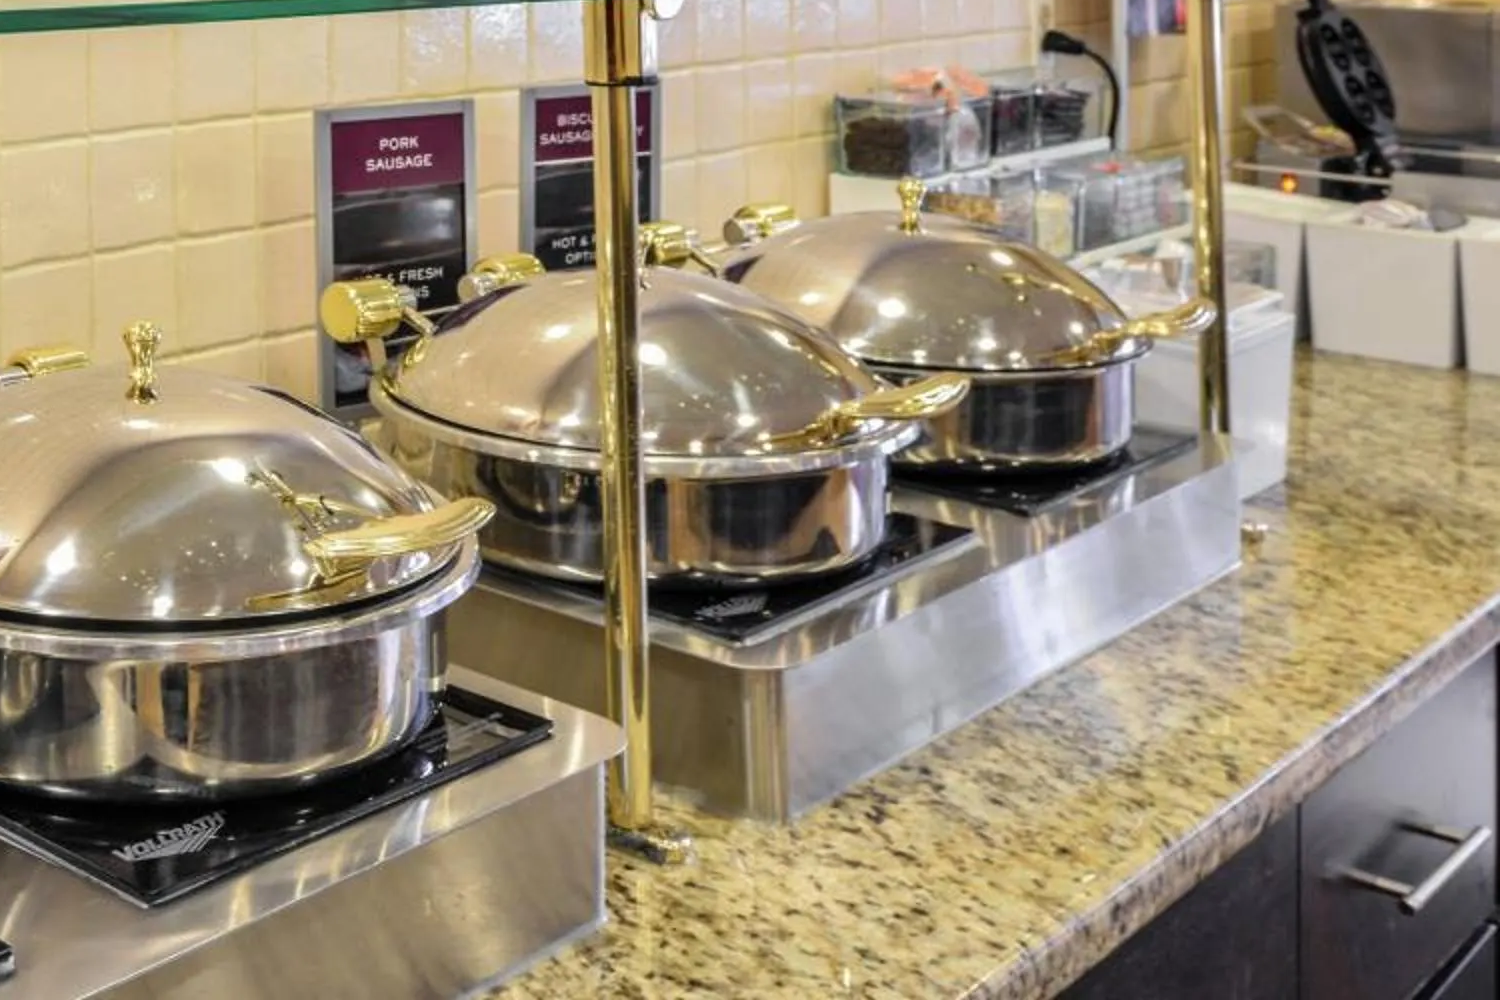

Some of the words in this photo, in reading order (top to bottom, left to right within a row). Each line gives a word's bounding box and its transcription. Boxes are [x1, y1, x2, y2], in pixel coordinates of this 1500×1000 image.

[379, 135, 420, 151] PORK
[539, 129, 592, 146] SAUSAG
[365, 153, 433, 172] SAUSAGE
[552, 235, 577, 249] HOT
[399, 266, 444, 282] FRESH
